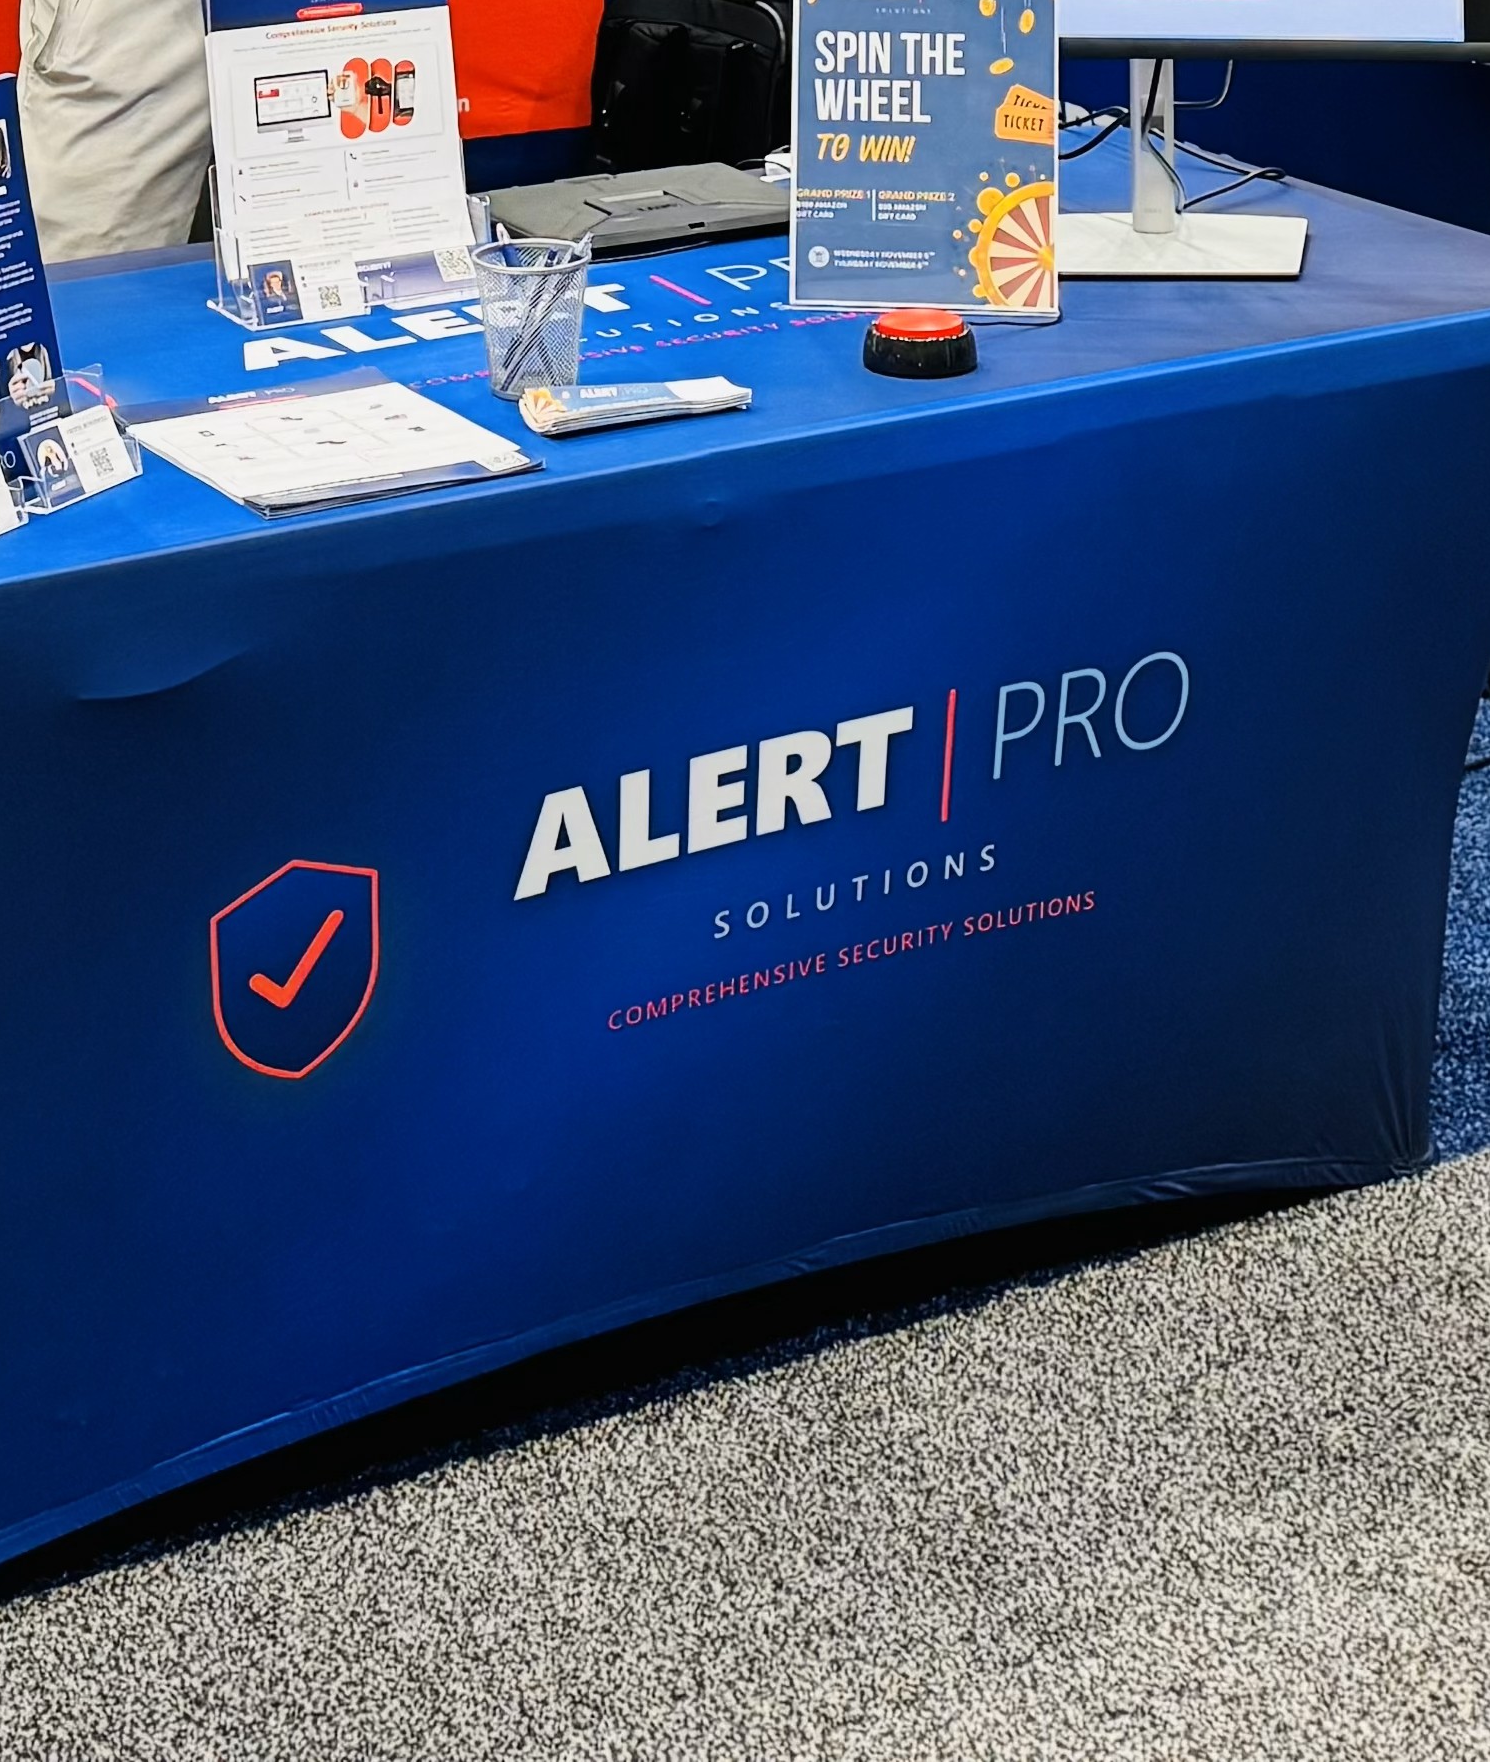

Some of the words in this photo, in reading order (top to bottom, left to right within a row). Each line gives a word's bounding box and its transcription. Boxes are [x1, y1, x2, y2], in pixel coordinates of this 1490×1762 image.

[814, 30, 892, 75] SPIN
[900, 32, 966, 76] THE
[814, 79, 932, 124] WHEEL
[1004, 114, 1044, 132] TICKET
[817, 133, 850, 162] TO
[860, 134, 916, 163] WIN!
[512, 704, 914, 902] ALERT
[991, 649, 1191, 781] PRO
[711, 842, 1000, 941] SOLUTIONS
[607, 955, 828, 1033] COMPREHENSIVE
[836, 920, 956, 969] SECURITY
[963, 889, 1097, 938] SOLUTIONS
